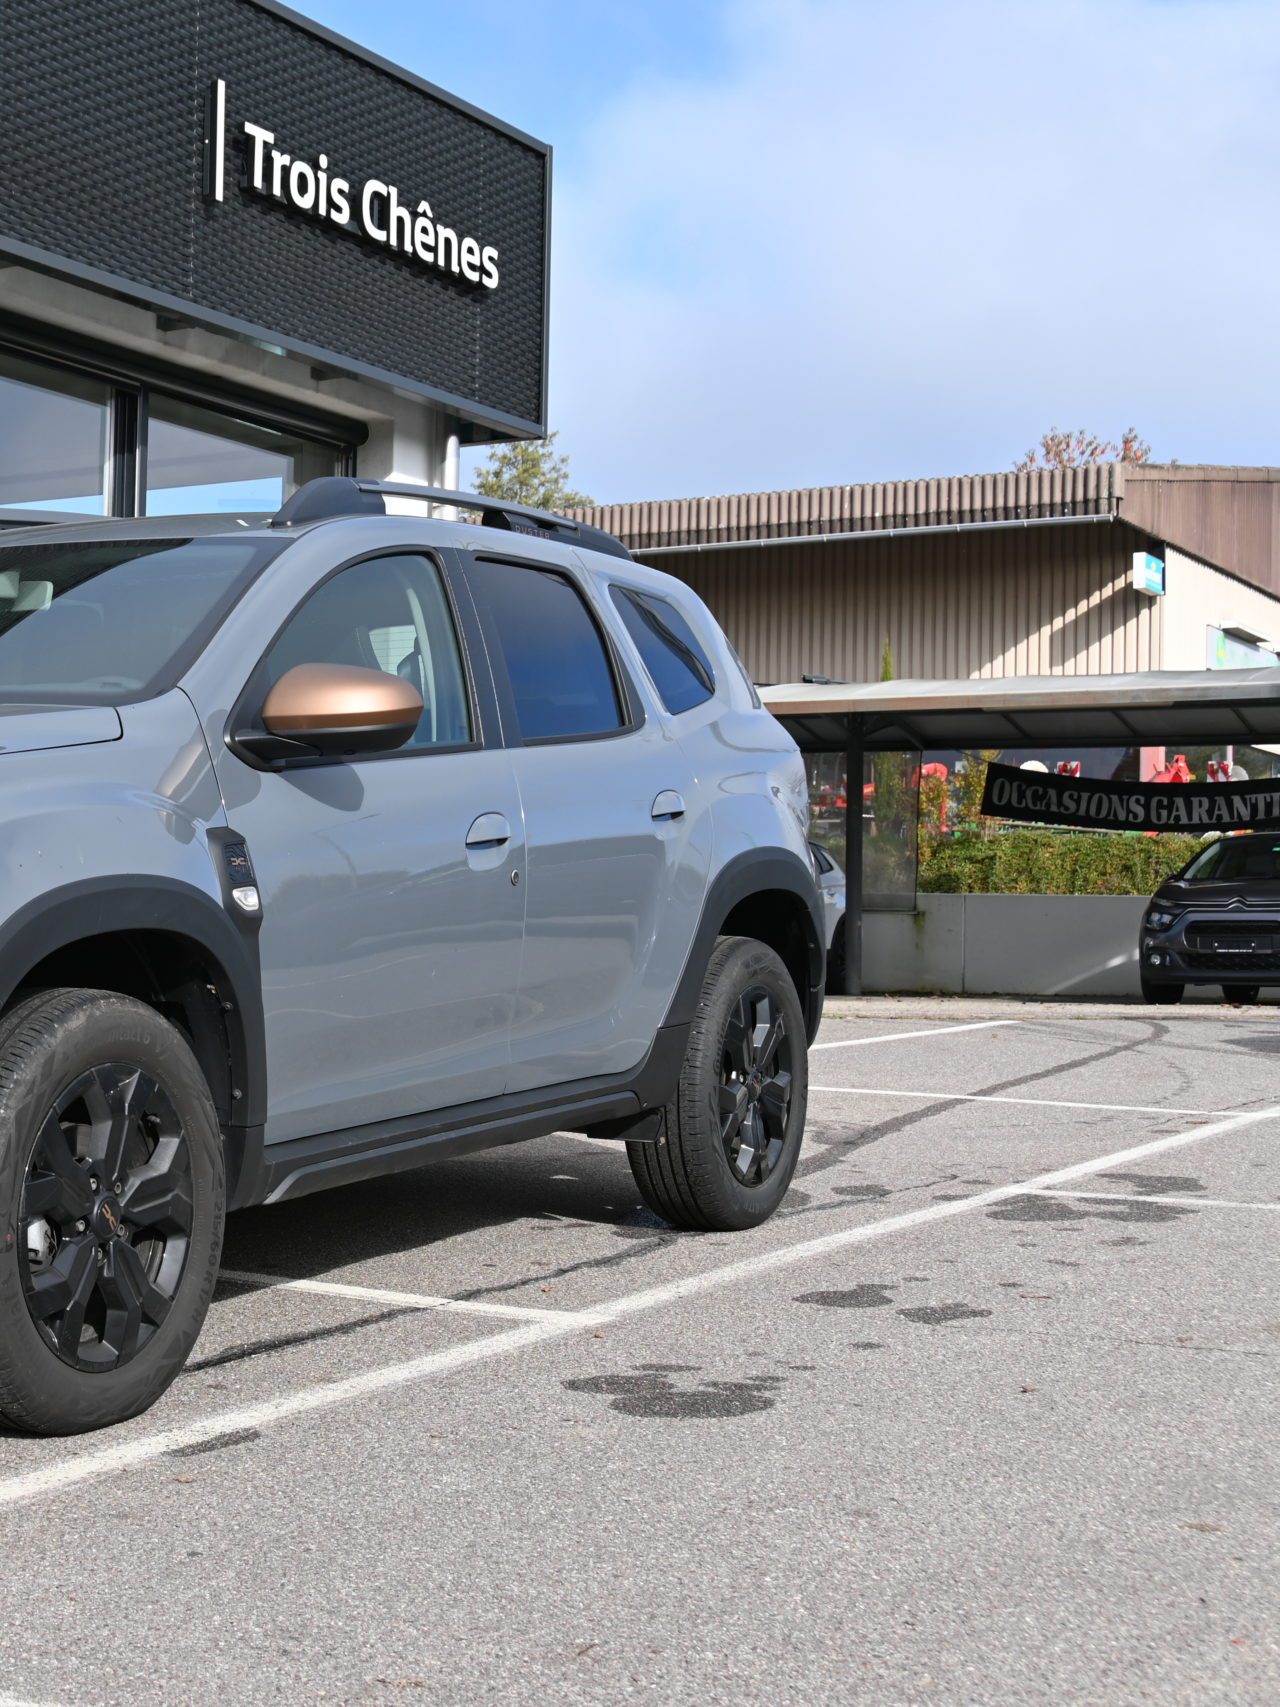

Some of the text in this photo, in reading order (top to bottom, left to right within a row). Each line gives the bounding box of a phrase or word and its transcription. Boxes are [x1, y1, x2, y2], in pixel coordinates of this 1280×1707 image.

[244, 121, 500, 289] Trois Chênes
[515, 524, 550, 539] DUSTER
[992, 777, 1145, 823] OCCASIONS
